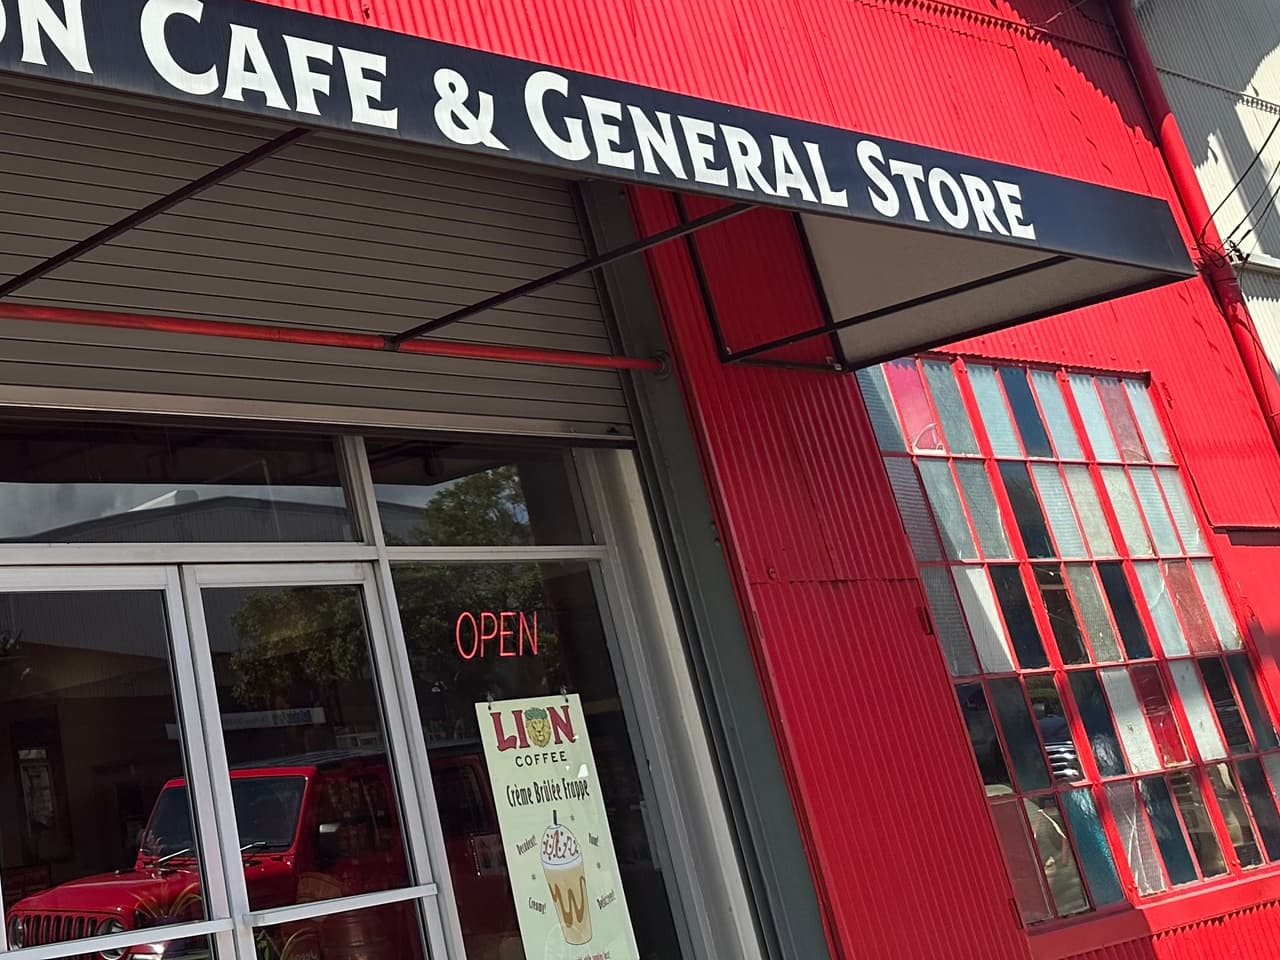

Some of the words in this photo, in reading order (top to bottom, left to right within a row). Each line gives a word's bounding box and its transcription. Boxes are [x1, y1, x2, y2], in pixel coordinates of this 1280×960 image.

[433, 68, 509, 151] &
[524, 71, 848, 208] GENERAL
[855, 141, 1036, 240] STORE
[456, 611, 538, 659] OPEN
[515, 751, 567, 767] COFFEE
[506, 784, 534, 807] Crème
[533, 779, 562, 803] Brûlée
[562, 777, 590, 800] Frappe
